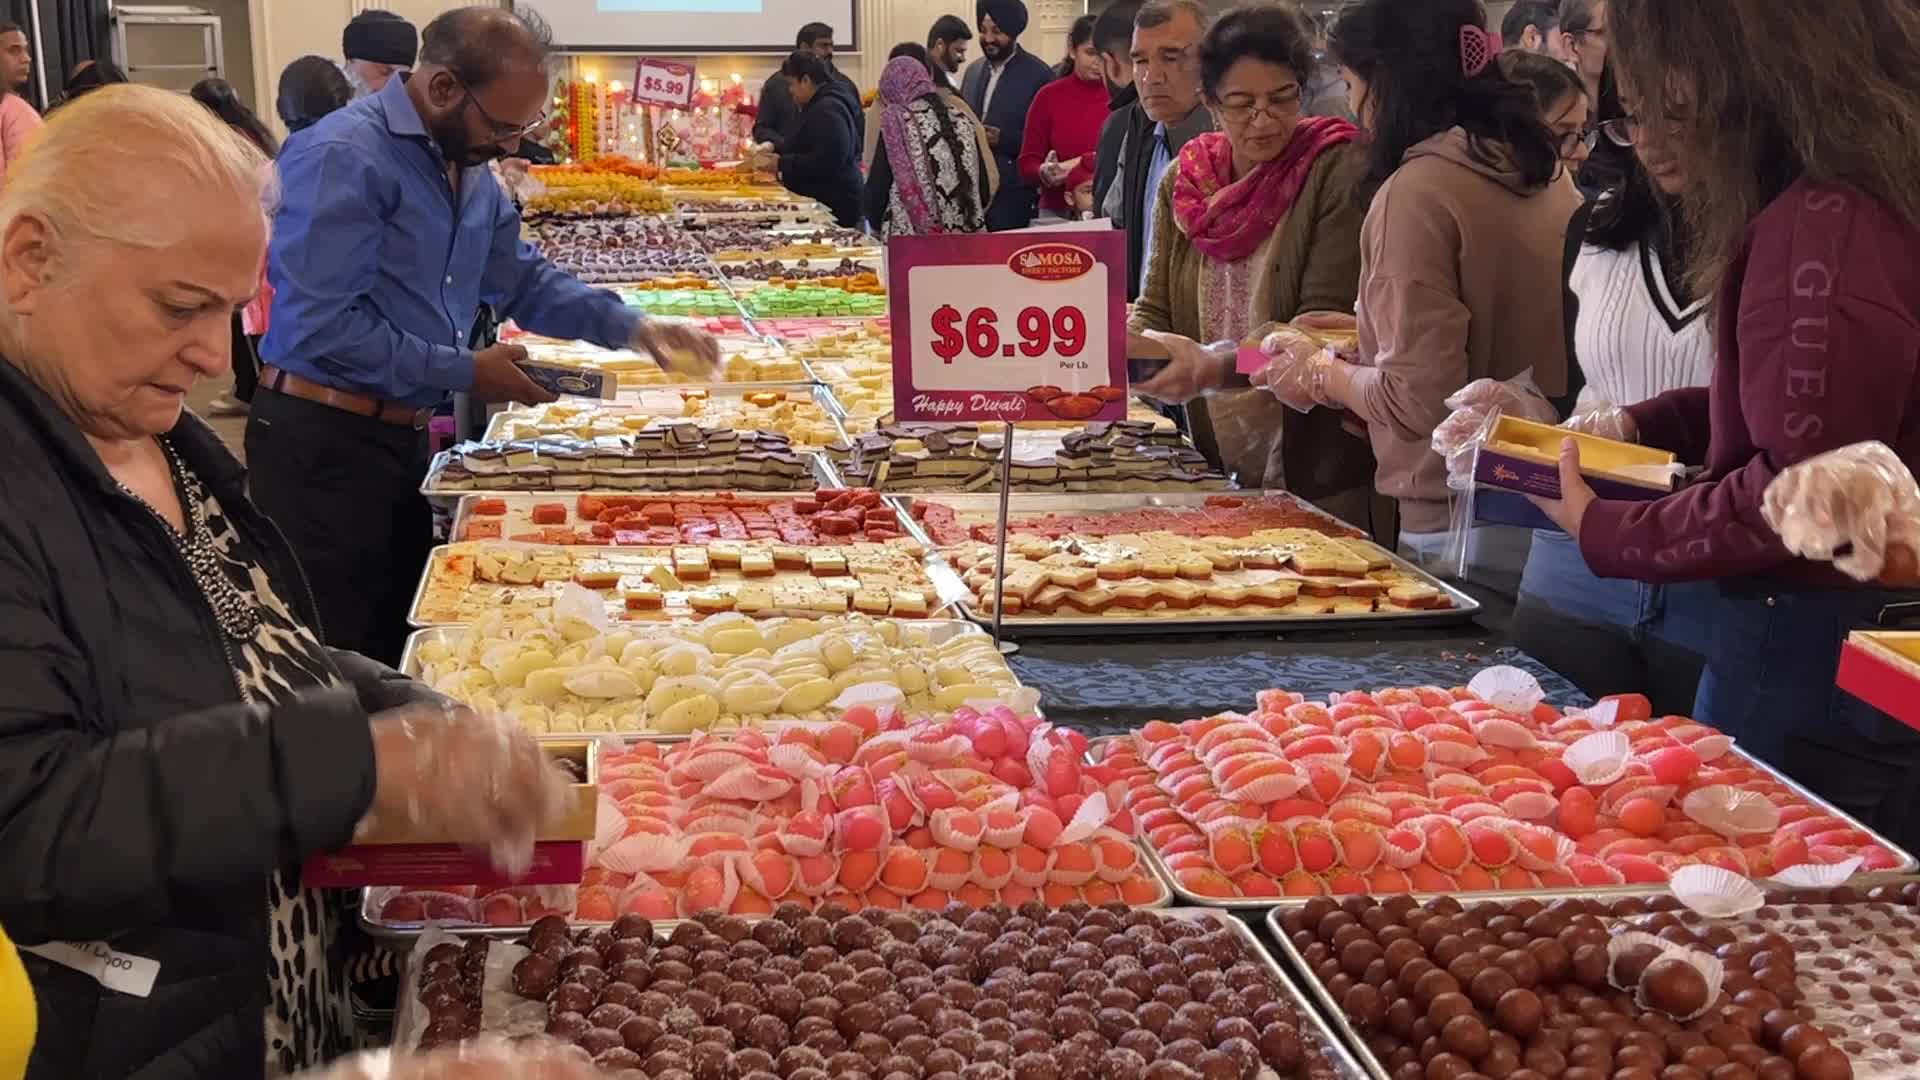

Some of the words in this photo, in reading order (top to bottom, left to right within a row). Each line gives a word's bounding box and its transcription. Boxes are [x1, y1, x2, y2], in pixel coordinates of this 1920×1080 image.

[643, 76, 684, 95] $5.99
[1020, 252, 1082, 267] SAMOSA
[930, 304, 1087, 364] $6.99
[1784, 259, 1833, 446] GUES
[1059, 361, 1074, 369] Per
[1076, 361, 1089, 369] Lb
[912, 394, 964, 416] Happy
[970, 394, 1022, 411] Diwali
